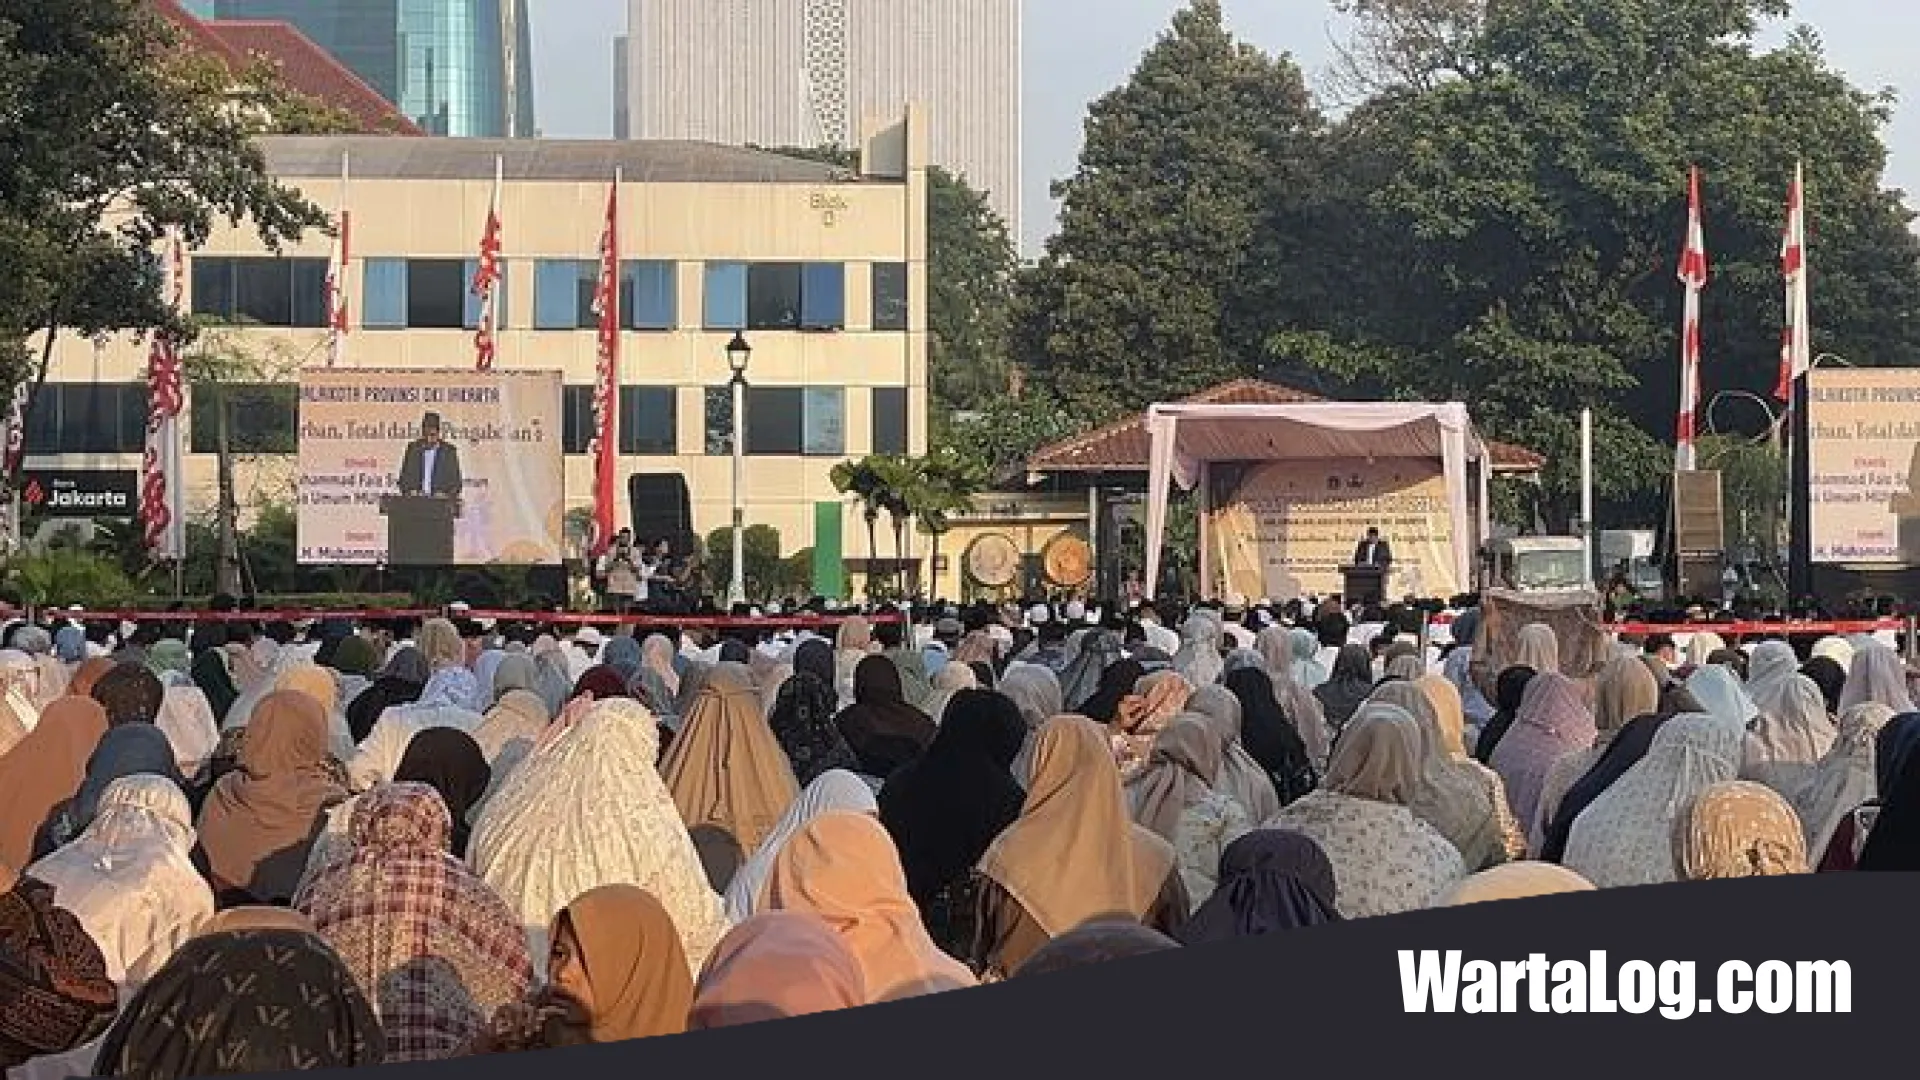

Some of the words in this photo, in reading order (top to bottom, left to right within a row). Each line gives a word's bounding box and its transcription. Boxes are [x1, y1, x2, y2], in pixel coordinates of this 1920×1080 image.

[364, 387, 420, 402] PROVINSI
[347, 421, 386, 440] Total
[48, 490, 127, 506] Jakarta
